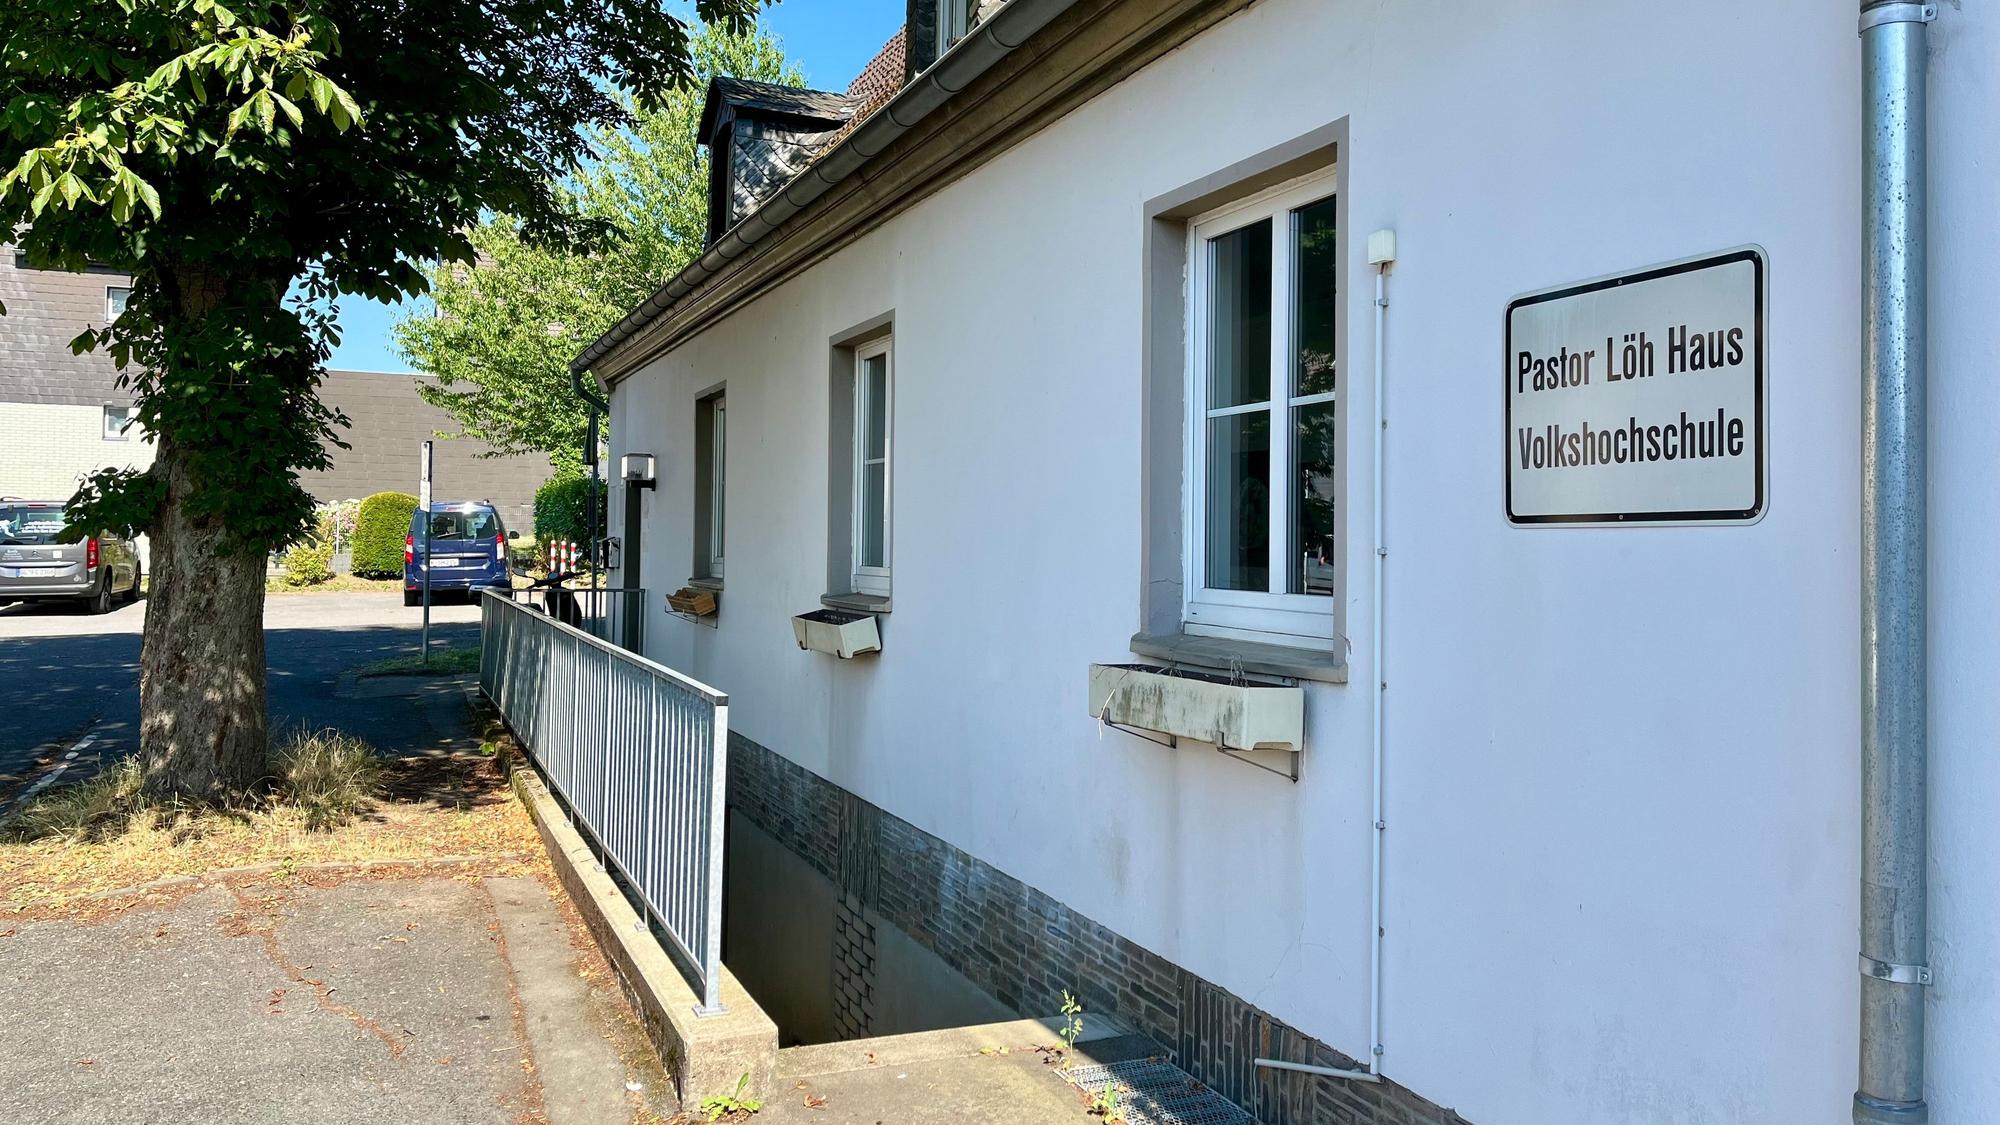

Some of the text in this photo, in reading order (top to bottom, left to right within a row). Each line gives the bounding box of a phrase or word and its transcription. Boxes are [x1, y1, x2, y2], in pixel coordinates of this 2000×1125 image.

[1518, 324, 1744, 393] Pastor Löh Haus
[1518, 408, 1744, 470] Volkshochschule
